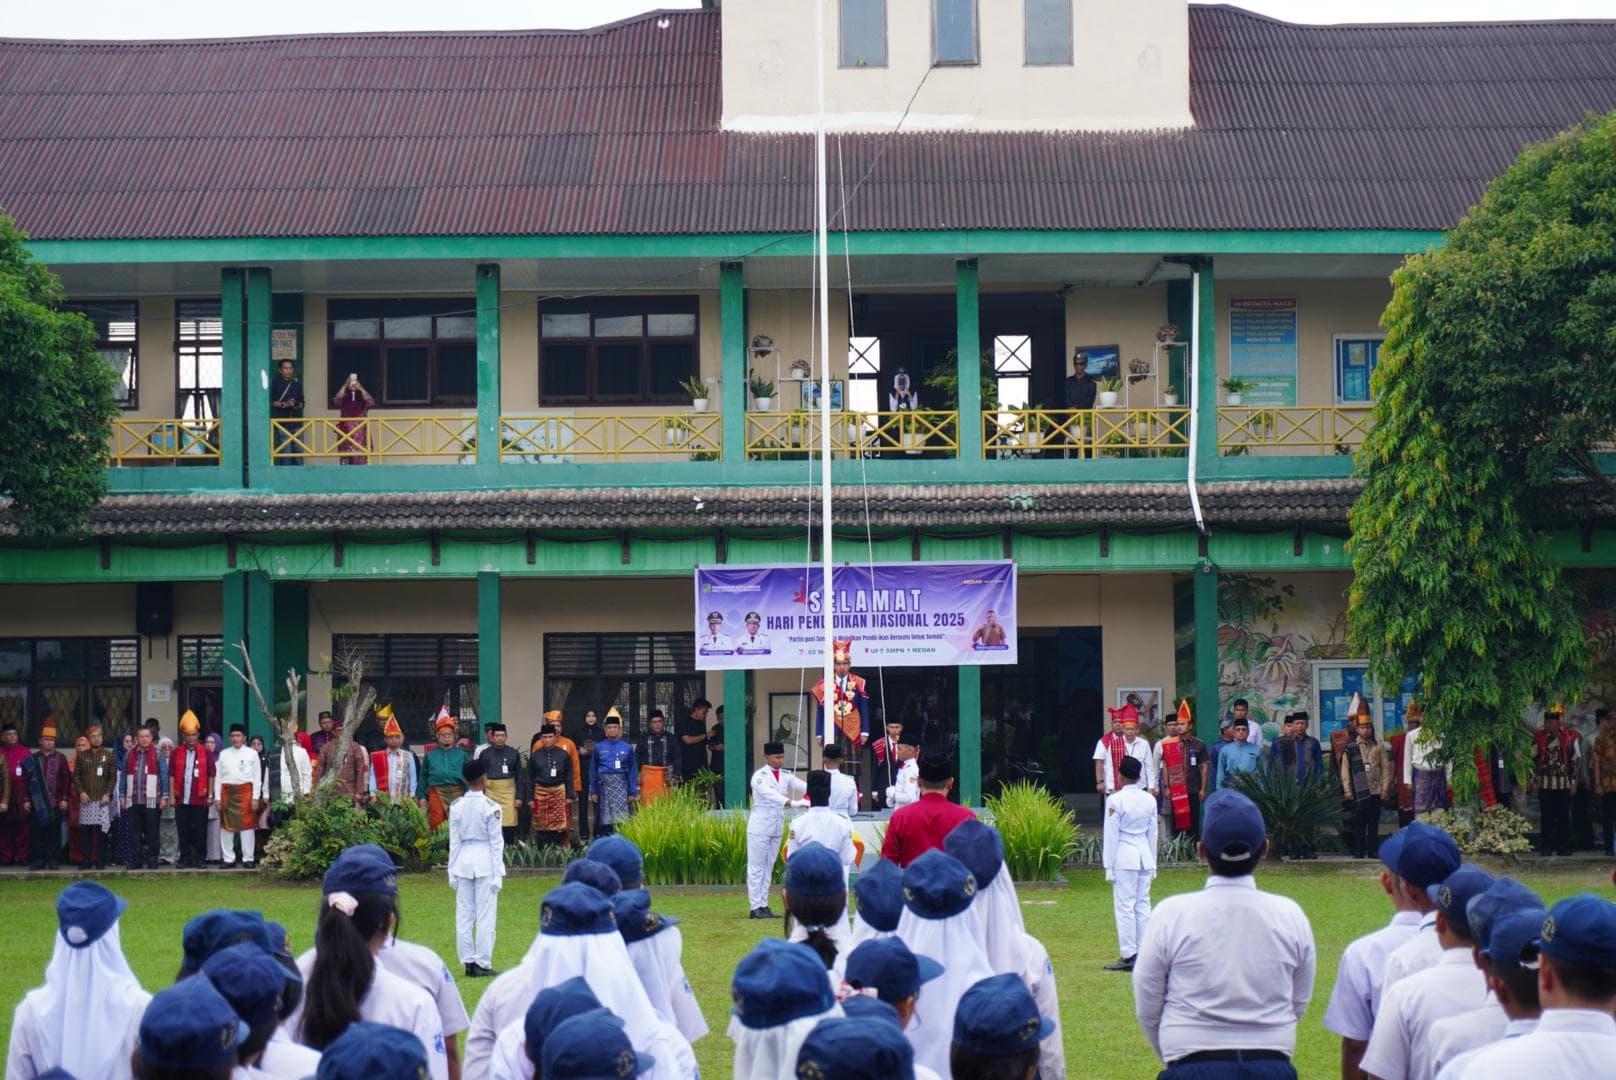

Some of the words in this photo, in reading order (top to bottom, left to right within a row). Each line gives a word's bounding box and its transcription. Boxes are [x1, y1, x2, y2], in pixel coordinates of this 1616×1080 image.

[767, 616, 793, 630] HARI
[799, 614, 867, 630] PENDDIKAN
[872, 613, 929, 628] NASIONAL
[934, 613, 965, 627] 2025
